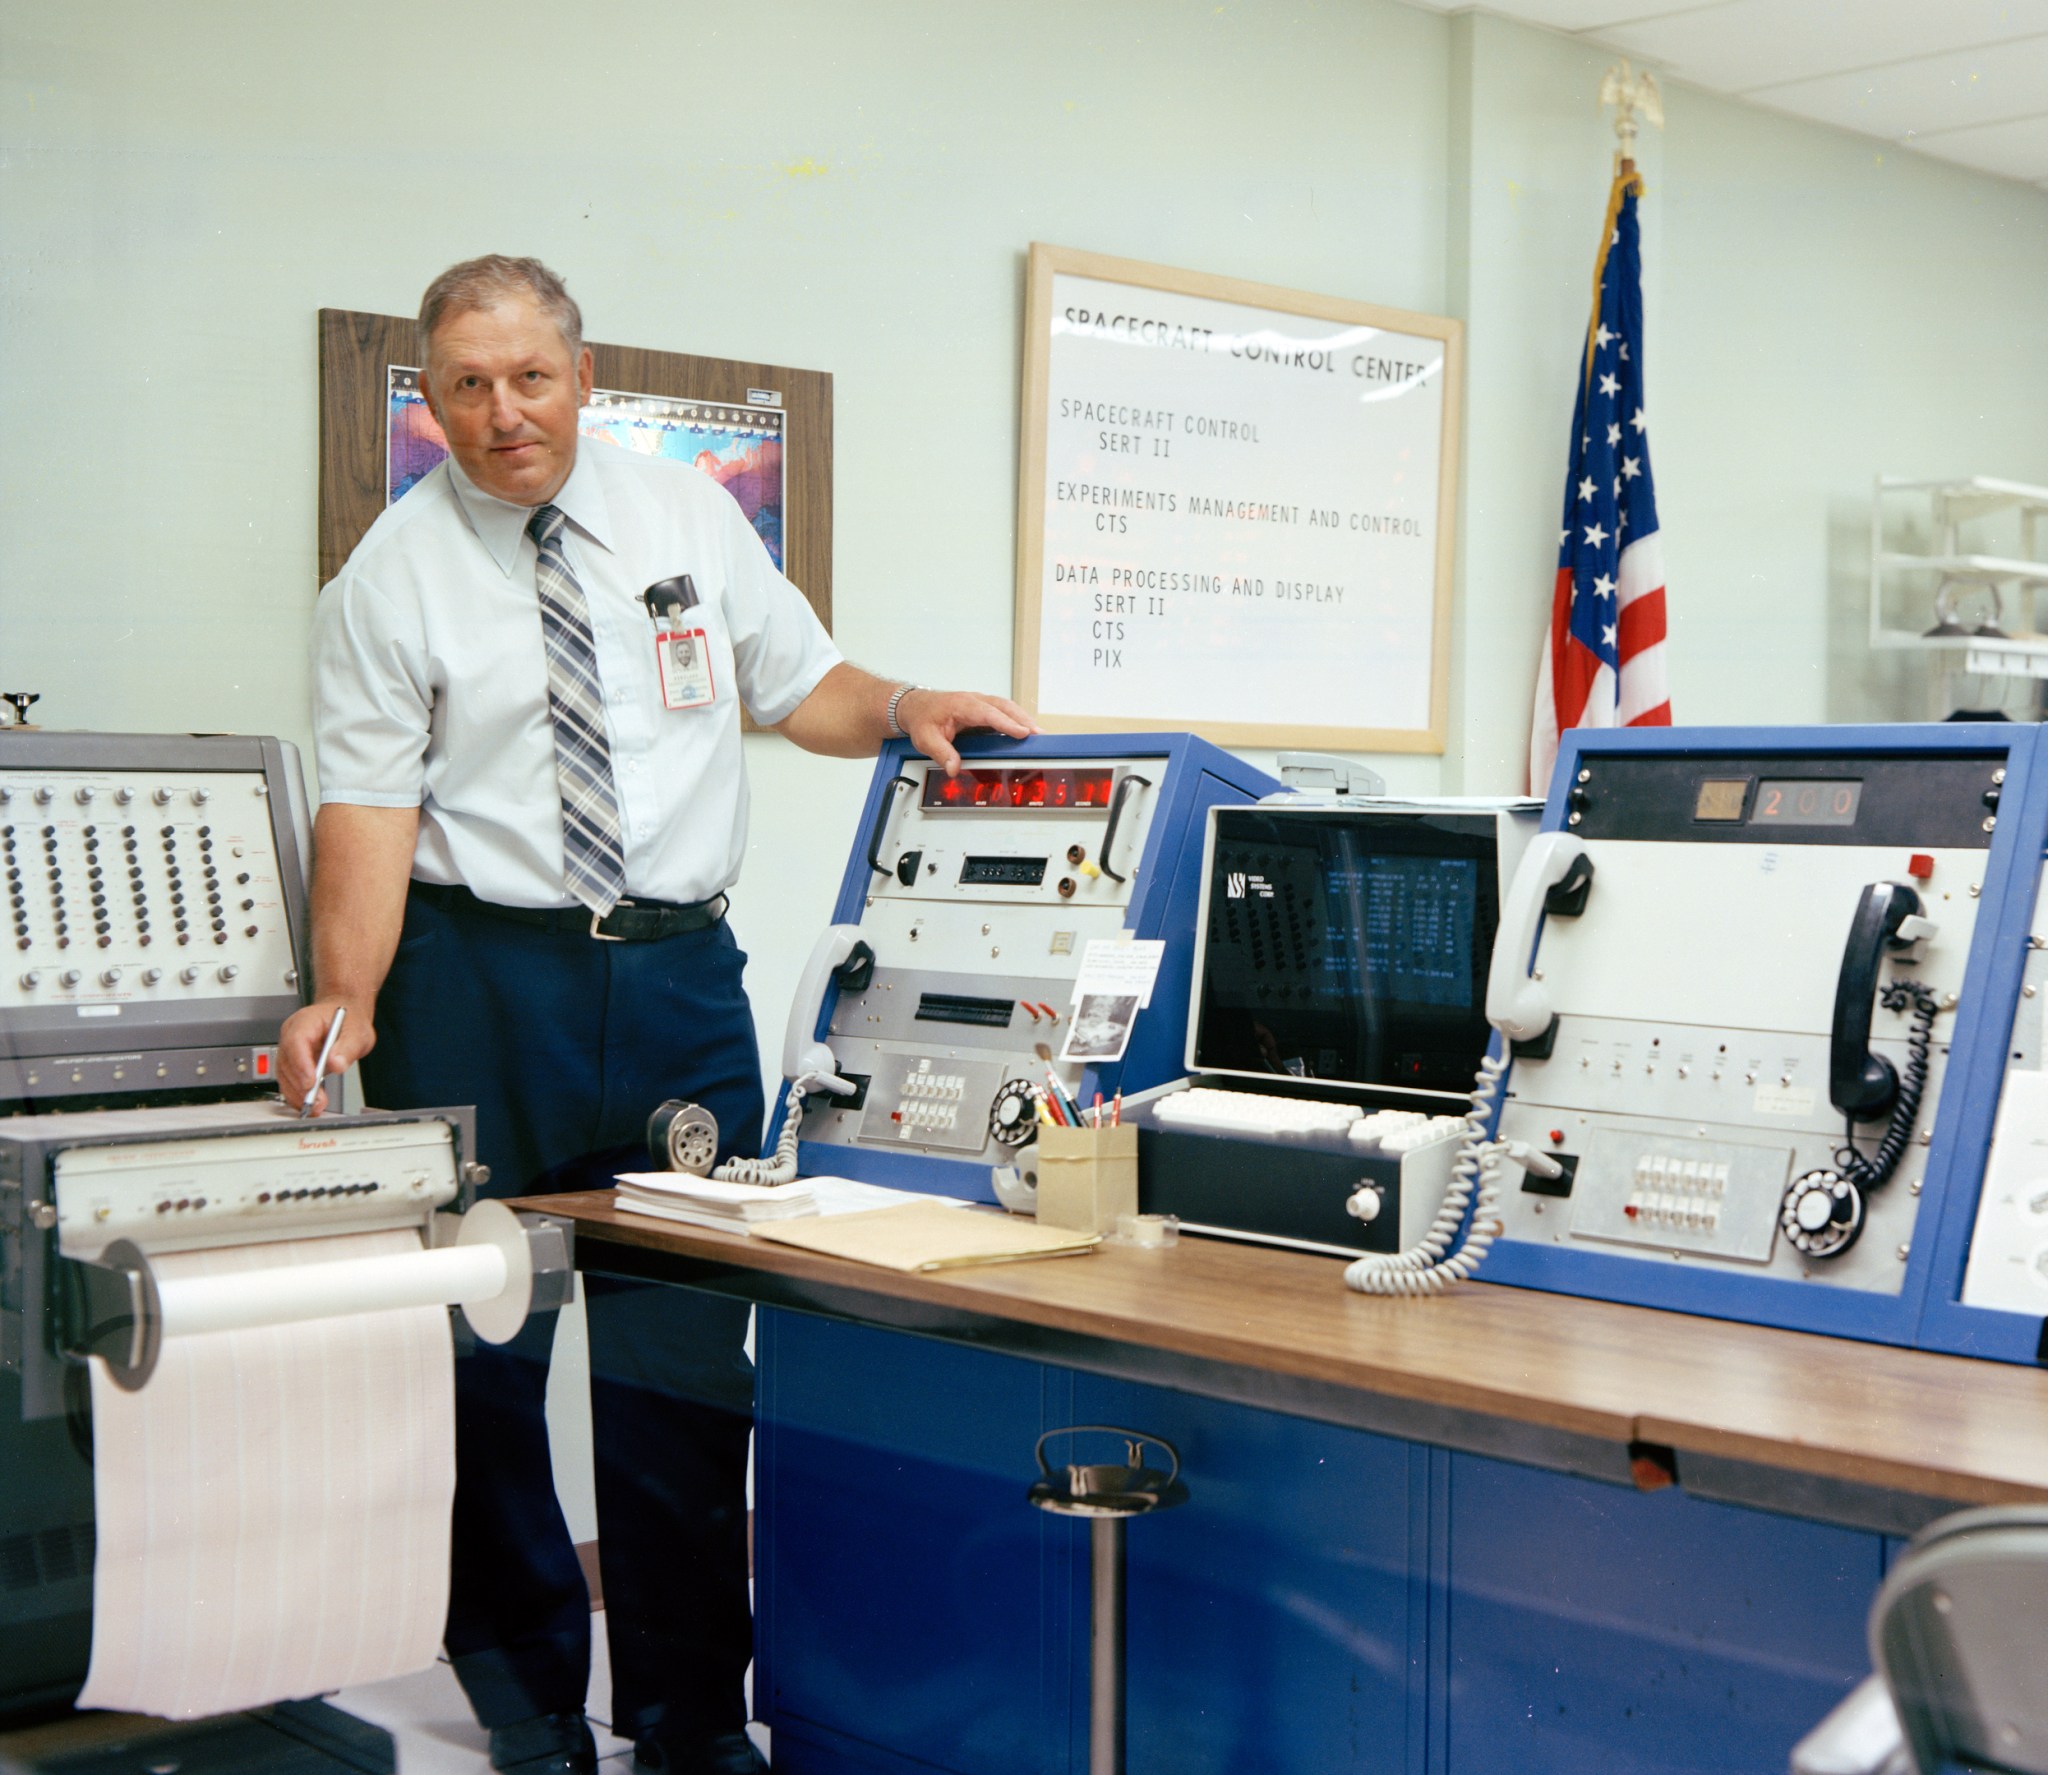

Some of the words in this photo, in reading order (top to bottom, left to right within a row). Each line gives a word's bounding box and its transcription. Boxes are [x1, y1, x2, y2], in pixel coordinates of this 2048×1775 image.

[1065, 307, 1213, 353] SPACECRAFT
[1230, 335, 1335, 373] CONTROL
[1352, 355, 1427, 387] CENTER
[1060, 398, 1175, 431] SPACECRAFT
[1184, 415, 1260, 443] CONTROL
[1099, 432, 1142, 455] SERT
[1154, 438, 1170, 457] II
[1057, 481, 1177, 513] EXPERIMENTS
[1188, 496, 1299, 525] MANAGEMENT
[1308, 509, 1340, 528] AND
[1350, 513, 1422, 537] CONTROL
[1095, 512, 1128, 534] CTS
[1056, 563, 1099, 585] DATA
[1112, 568, 1222, 594] PROCESSING
[1232, 577, 1264, 597] AND
[1276, 580, 1345, 603] DISPLAY
[1094, 593, 1136, 614] SERT
[1149, 597, 1165, 616] II
[1092, 620, 1125, 641] CTS
[1093, 648, 1122, 668] PIX
